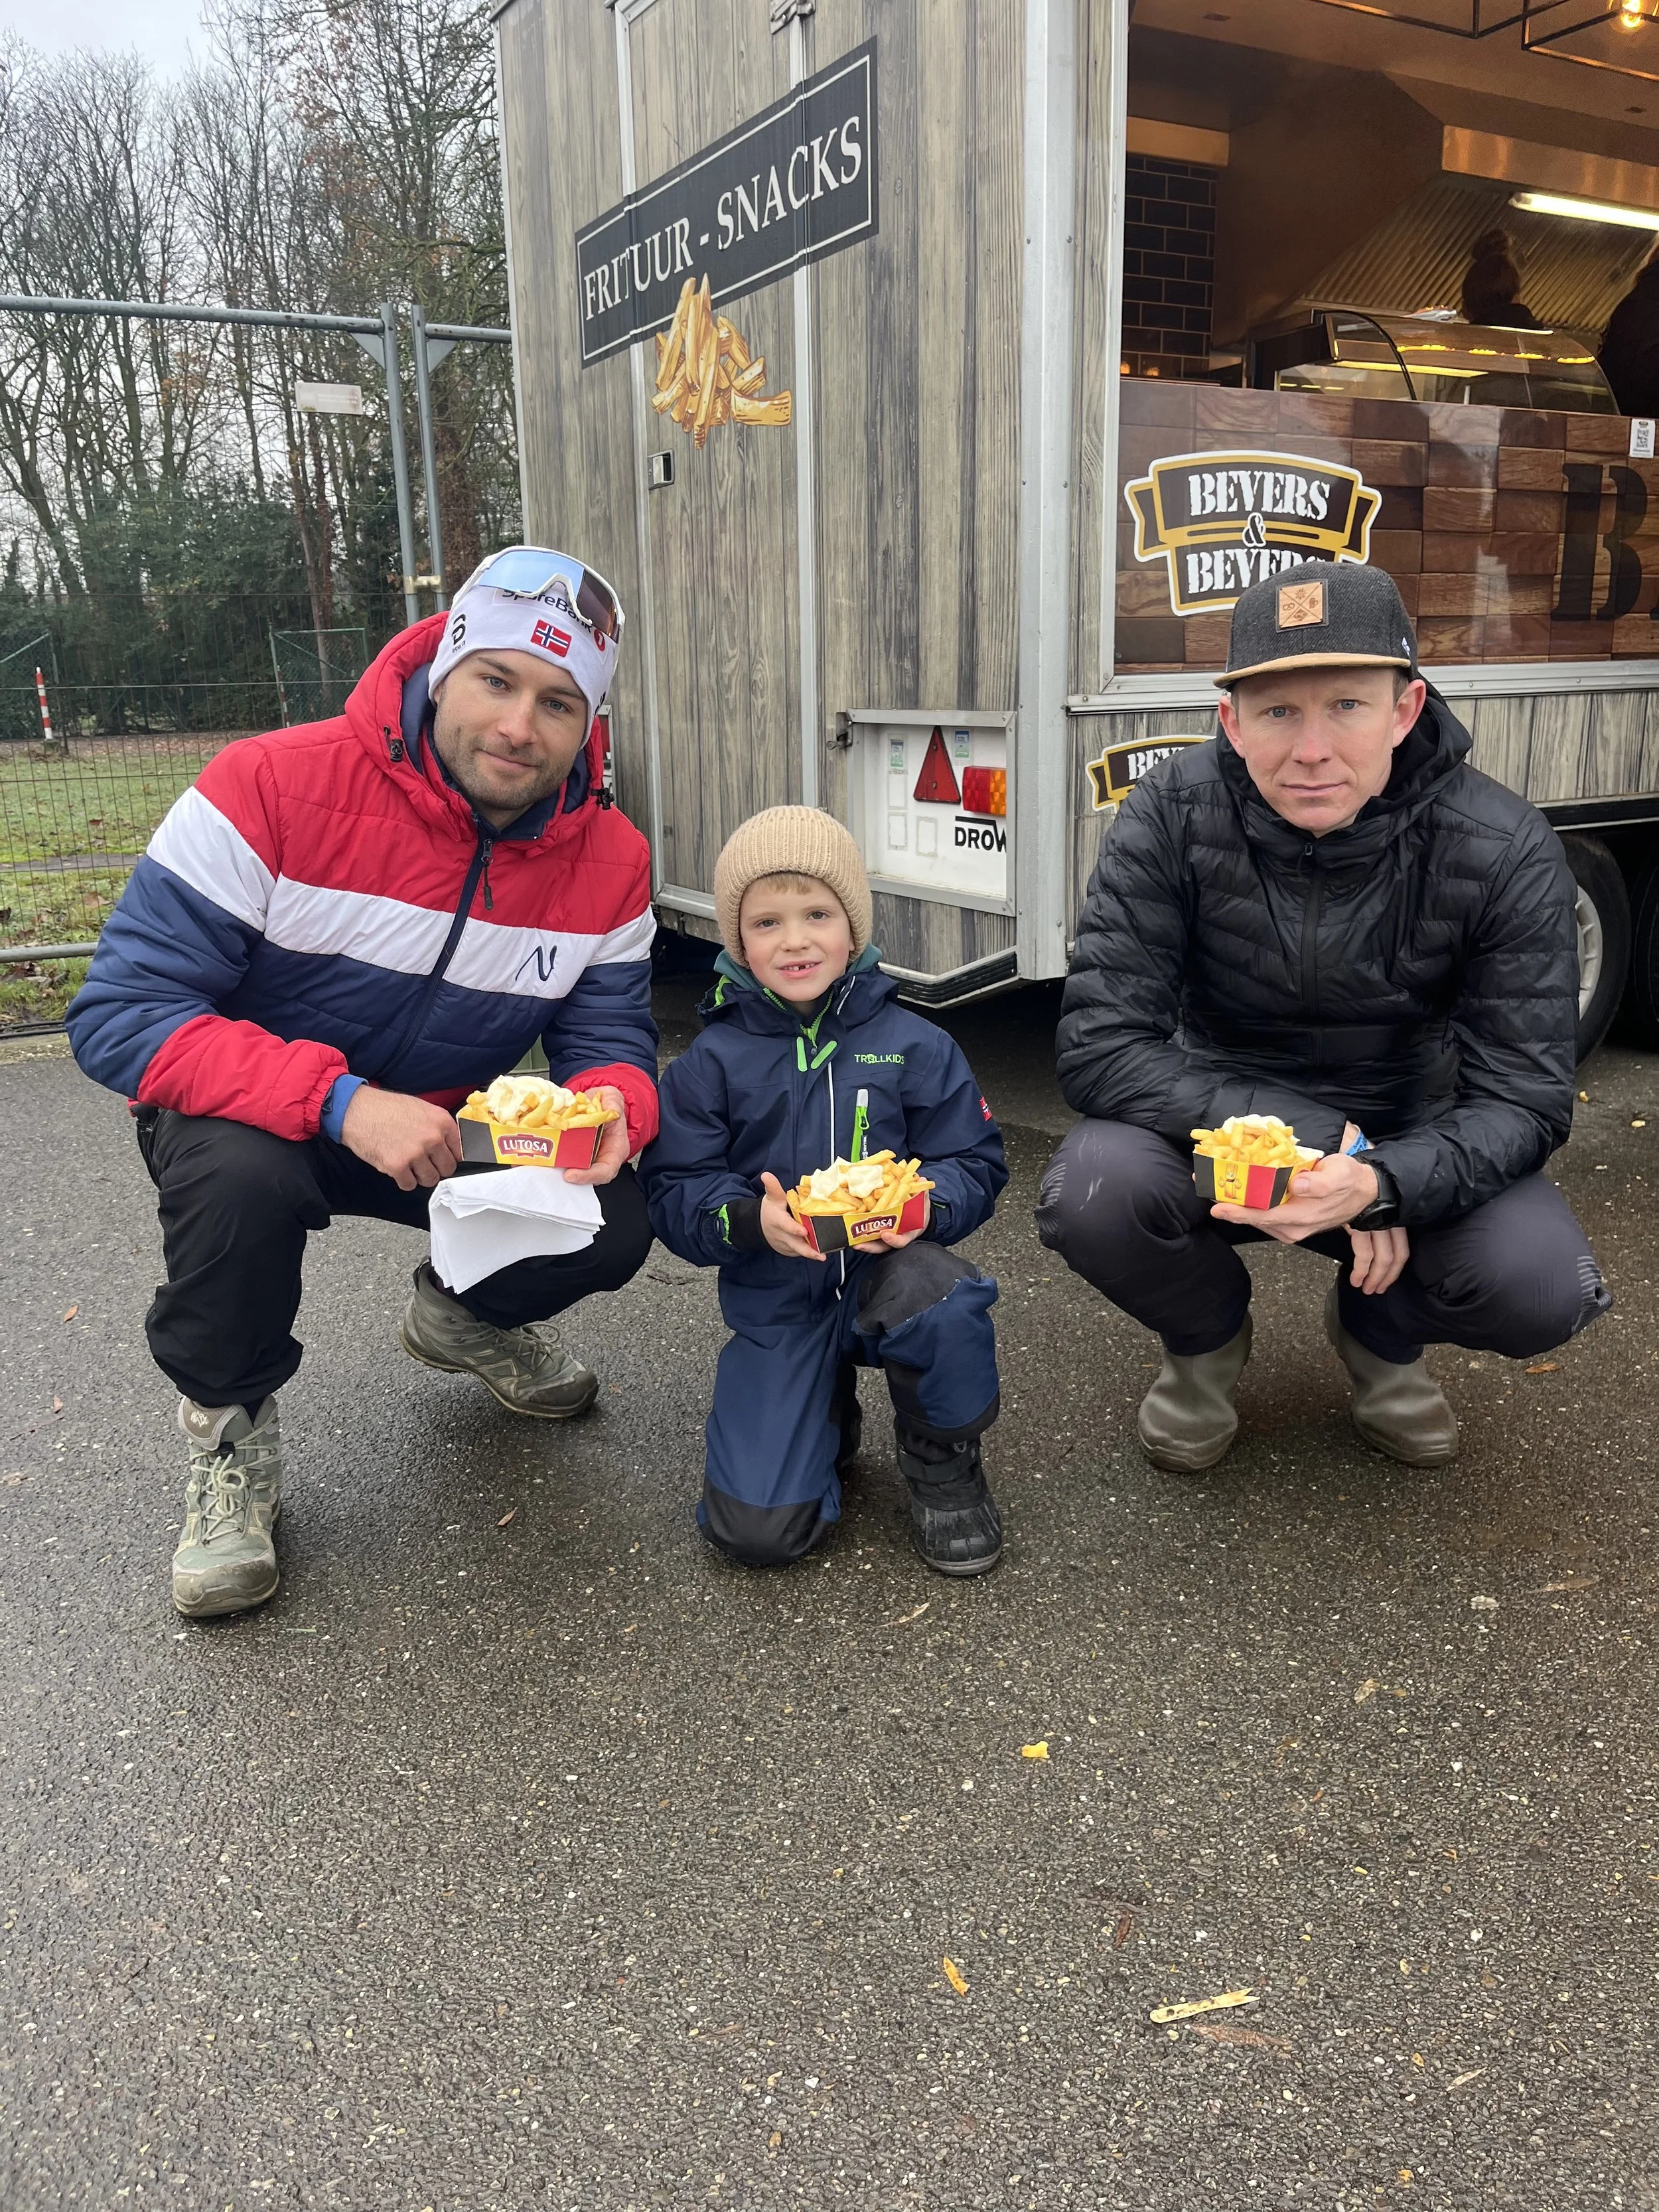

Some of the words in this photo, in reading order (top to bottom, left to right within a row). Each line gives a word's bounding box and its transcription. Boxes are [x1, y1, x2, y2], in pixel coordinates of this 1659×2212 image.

[584, 216, 693, 321] FRITUUR
[717, 115, 862, 250] SNACKS
[1187, 470, 1331, 520] BEVERS
[1242, 512, 1267, 548] &
[1551, 463, 1659, 622] B
[1186, 548, 1325, 594] BEVE
[854, 1053, 904, 1065] TROLLKIDS
[502, 1139, 548, 1153] LUTOSA
[855, 1218, 893, 1234] LUTOSA
